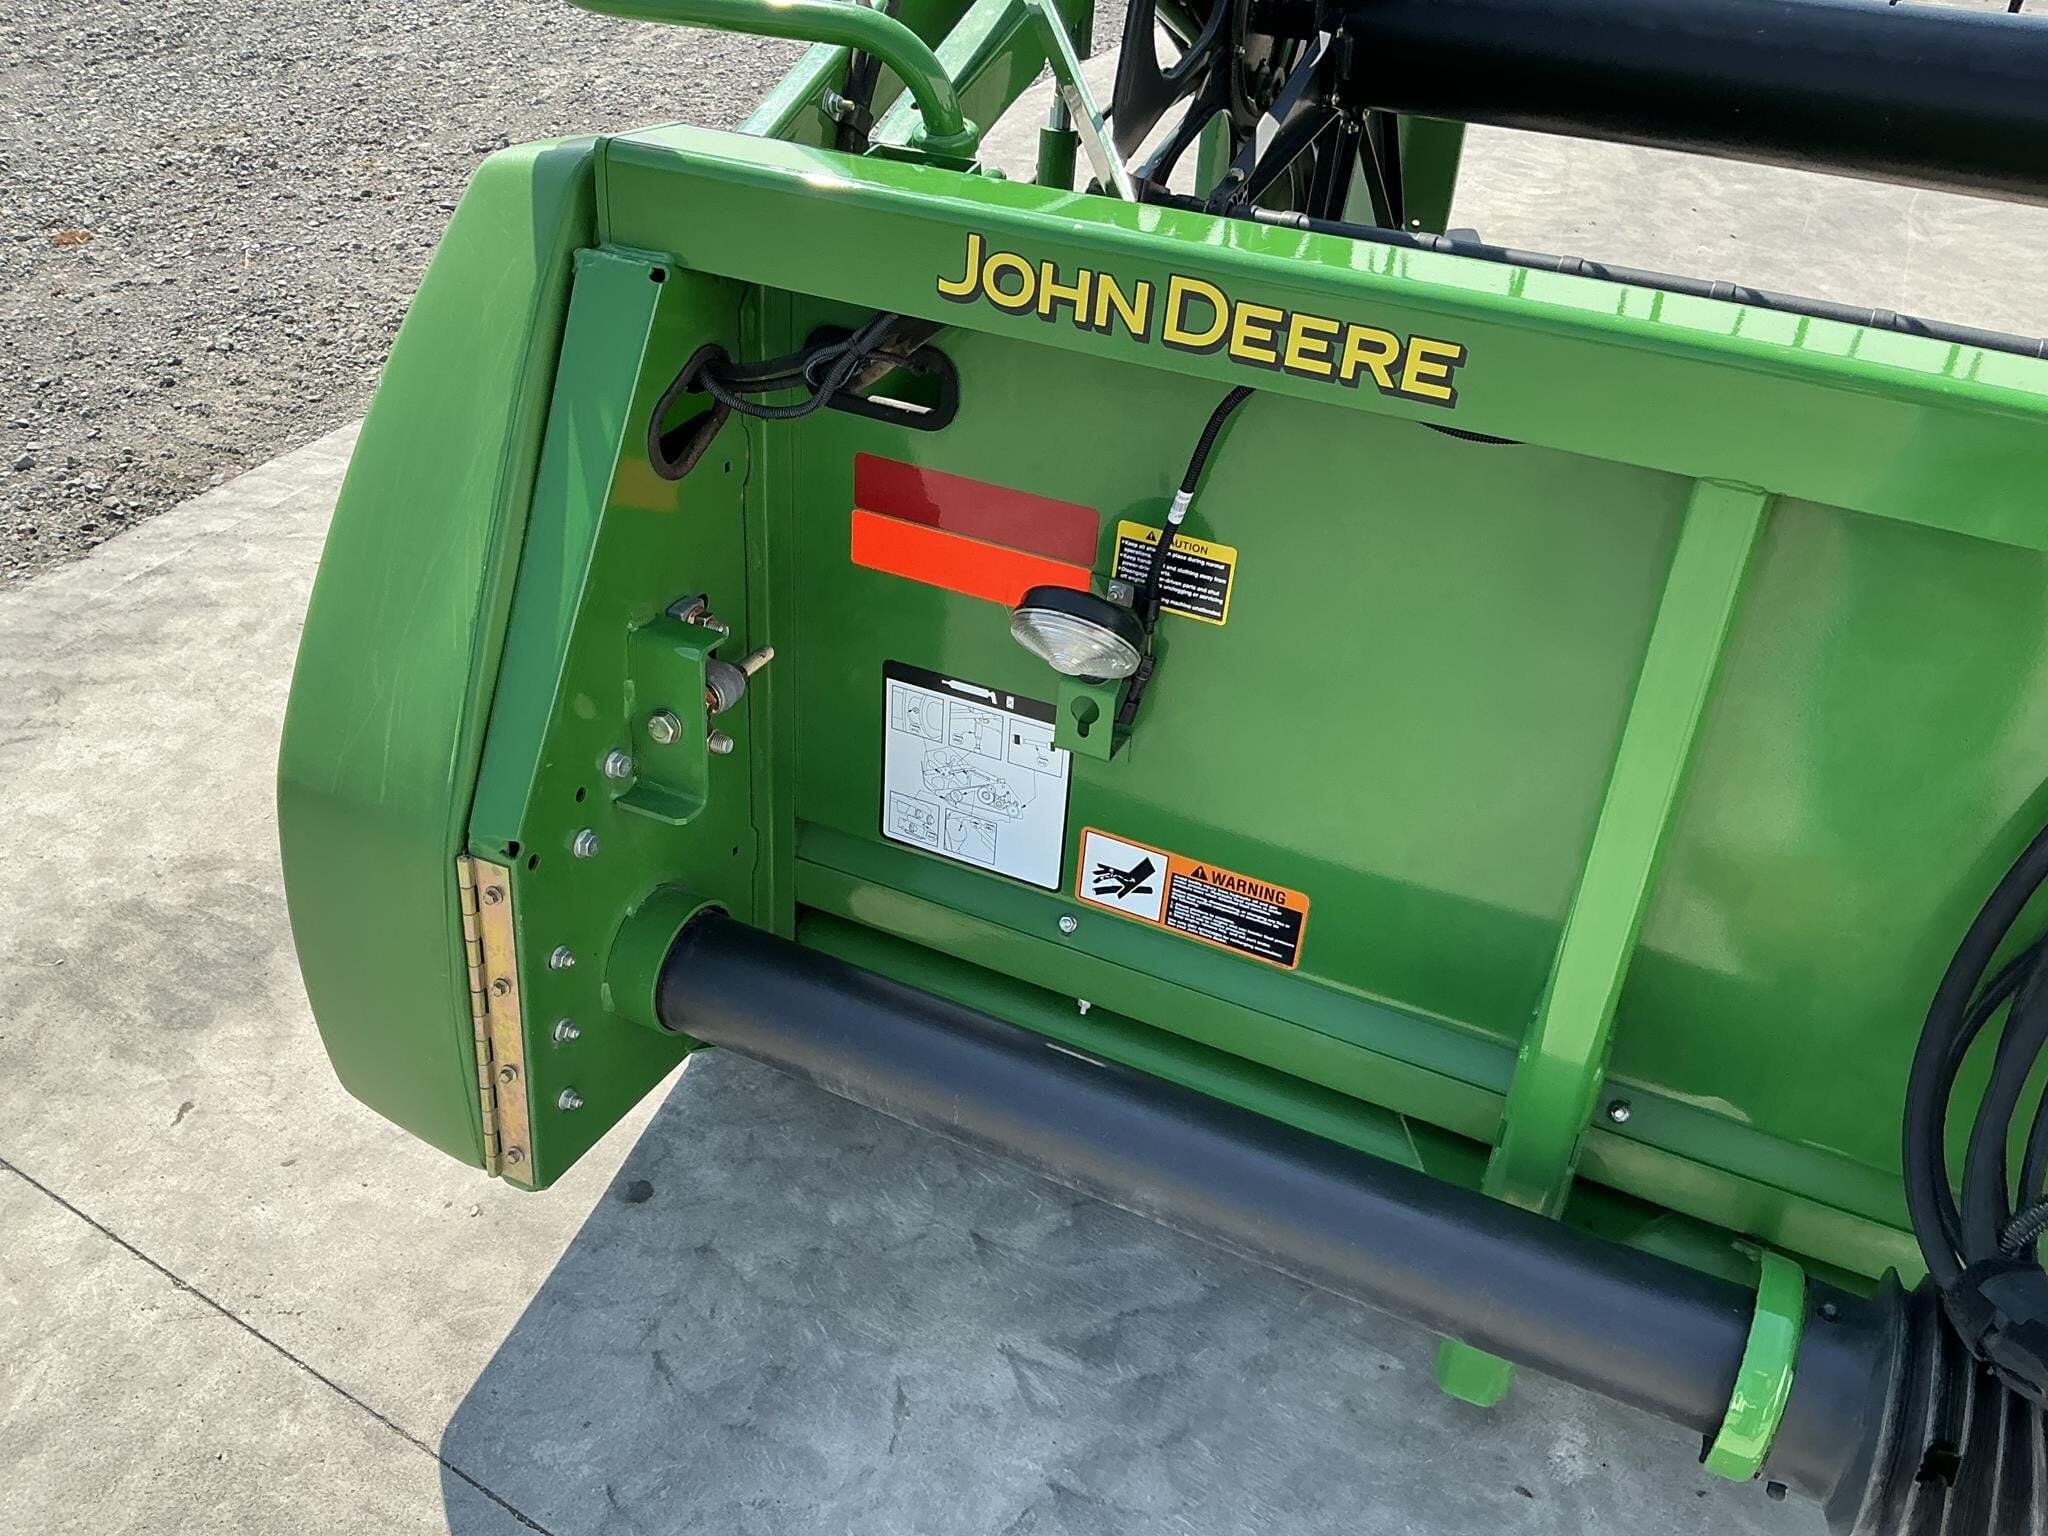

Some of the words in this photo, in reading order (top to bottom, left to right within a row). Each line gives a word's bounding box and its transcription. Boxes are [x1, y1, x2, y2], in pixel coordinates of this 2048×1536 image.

[937, 232, 1156, 344] JOHN
[1163, 272, 1467, 409] DEERE
[1171, 538, 1208, 555] UTION
[1210, 870, 1287, 905] WARNING
